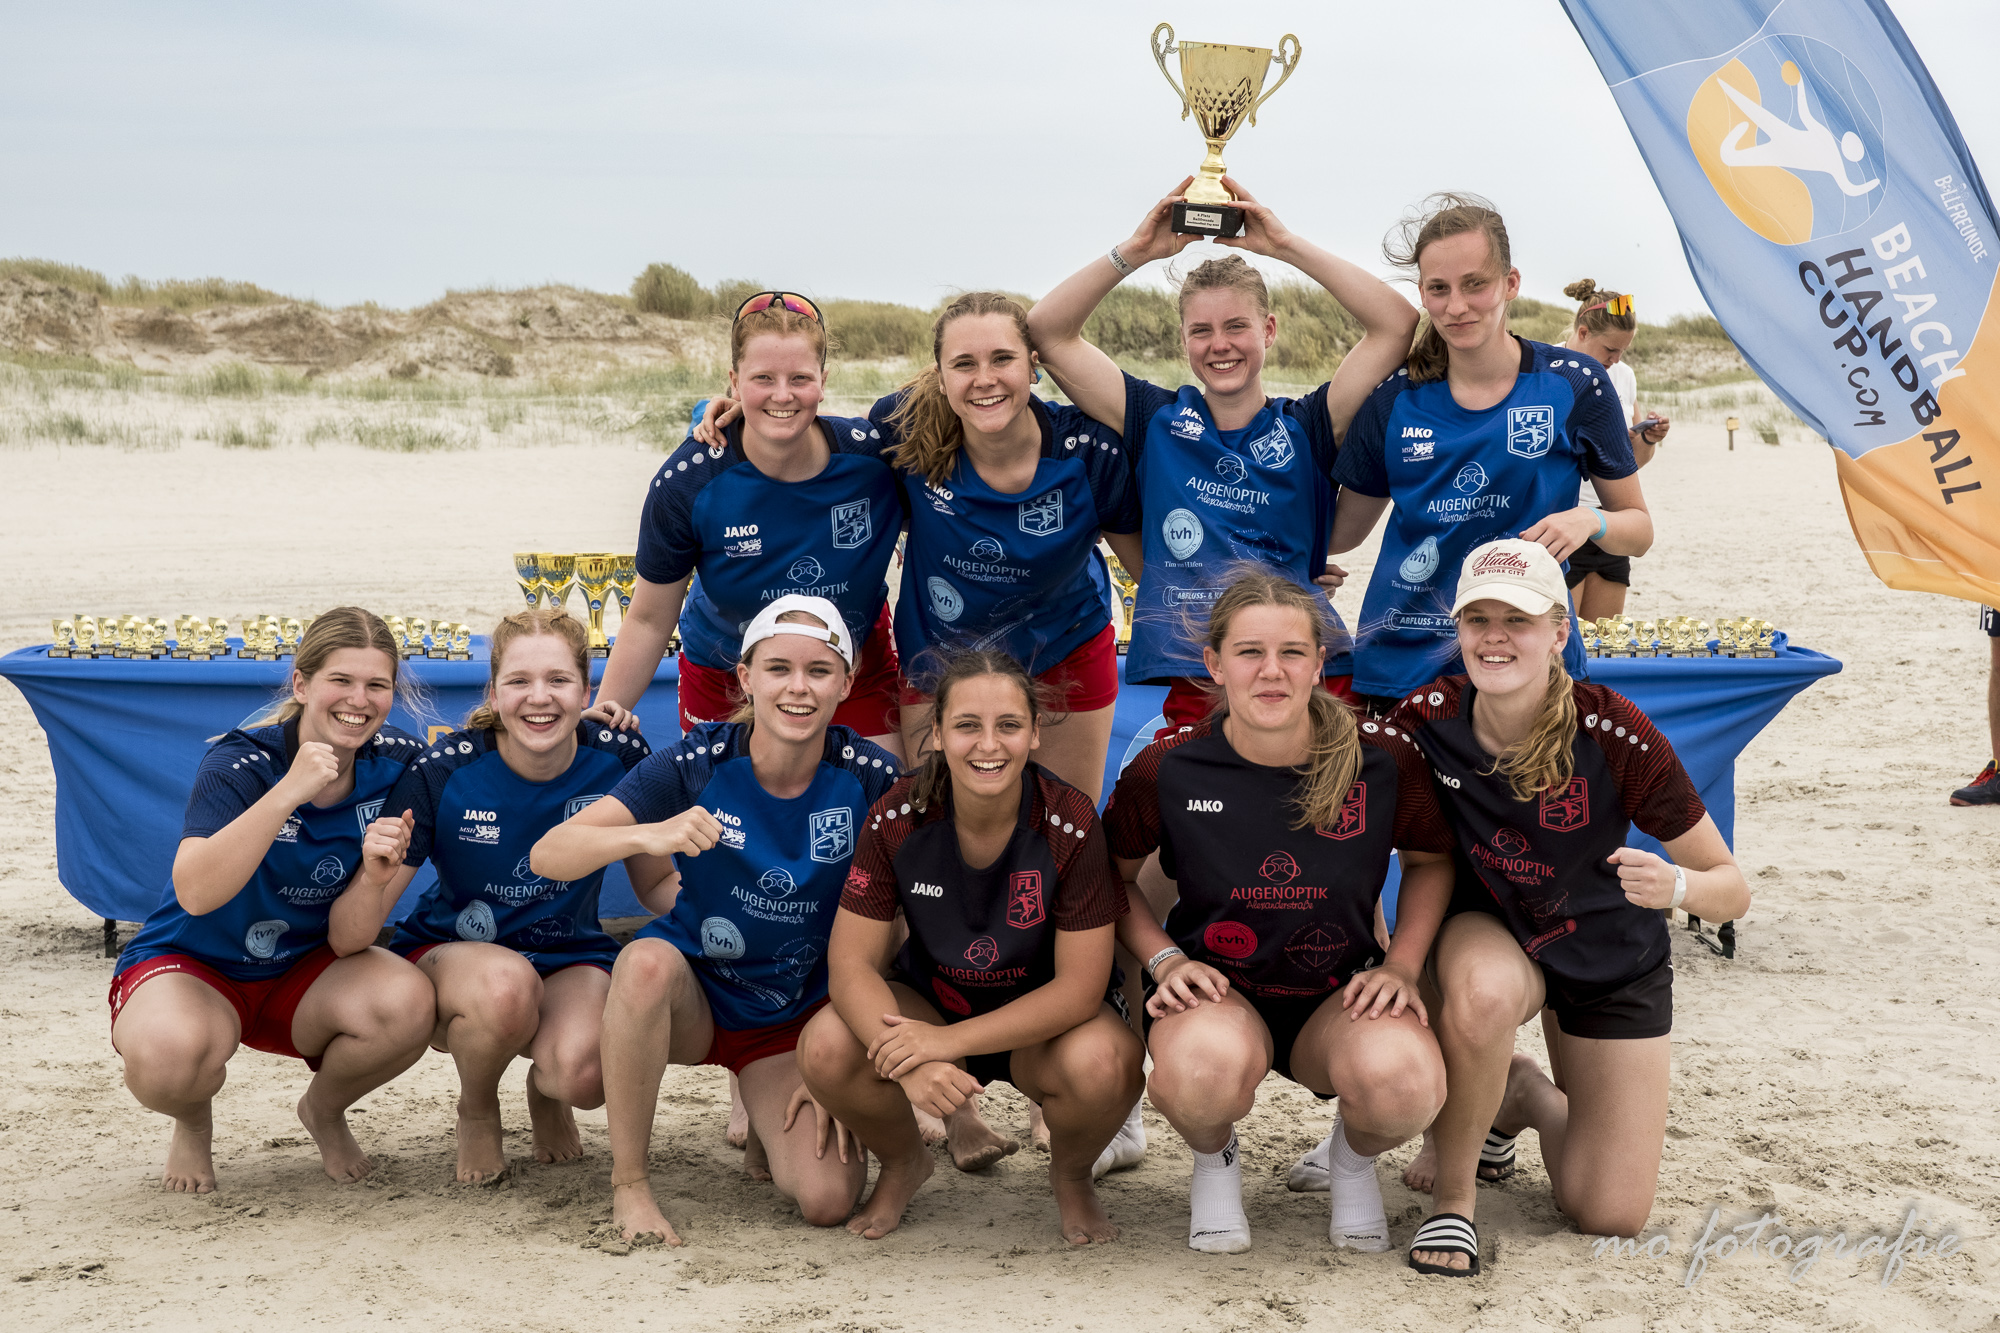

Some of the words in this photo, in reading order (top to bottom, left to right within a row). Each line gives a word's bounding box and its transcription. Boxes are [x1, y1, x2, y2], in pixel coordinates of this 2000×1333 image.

[1871, 222, 1967, 389] BEACH
[1799, 260, 1886, 427] CUP.COM
[1180, 407, 1205, 424] JAK
[1515, 411, 1547, 423] VFL
[1401, 427, 1433, 438] JAKO
[1186, 477, 1270, 505] AUGENOPTIK
[1197, 493, 1256, 515] Alexanderstraße
[1427, 494, 1511, 513] AUGENOPTIK
[838, 505, 865, 521] VFL
[724, 524, 759, 538] JAKO
[1170, 527, 1192, 540] tvh
[943, 554, 1031, 578] AUGENOPTIK
[1409, 551, 1426, 565] tvh
[1472, 547, 1531, 571] Studios
[1508, 569, 1526, 577] CITY
[932, 589, 953, 608] tvh
[1399, 616, 1434, 626] ABFLUSS-
[1435, 617, 1442, 626] &
[1186, 799, 1223, 812] JAKO
[463, 809, 497, 822] JAKO
[713, 808, 741, 827] JAKO
[816, 814, 847, 829] VFL
[459, 826, 477, 834] MSH
[1471, 843, 1556, 878] AUGENOPTIK
[484, 881, 570, 898] AUGENOPTIK
[911, 882, 943, 898] JAKO
[1230, 887, 1328, 900] AUGENOPTIK
[731, 885, 819, 914] AUGENOPTIK
[1246, 900, 1314, 911] Alexanderstraße
[741, 904, 805, 924] Alexanderstraße
[466, 914, 486, 936] tvh
[708, 931, 733, 950] tvh
[1216, 934, 1244, 945] tvh
[1221, 958, 1234, 966] von
[937, 964, 1028, 982] AUGENOPTIK
